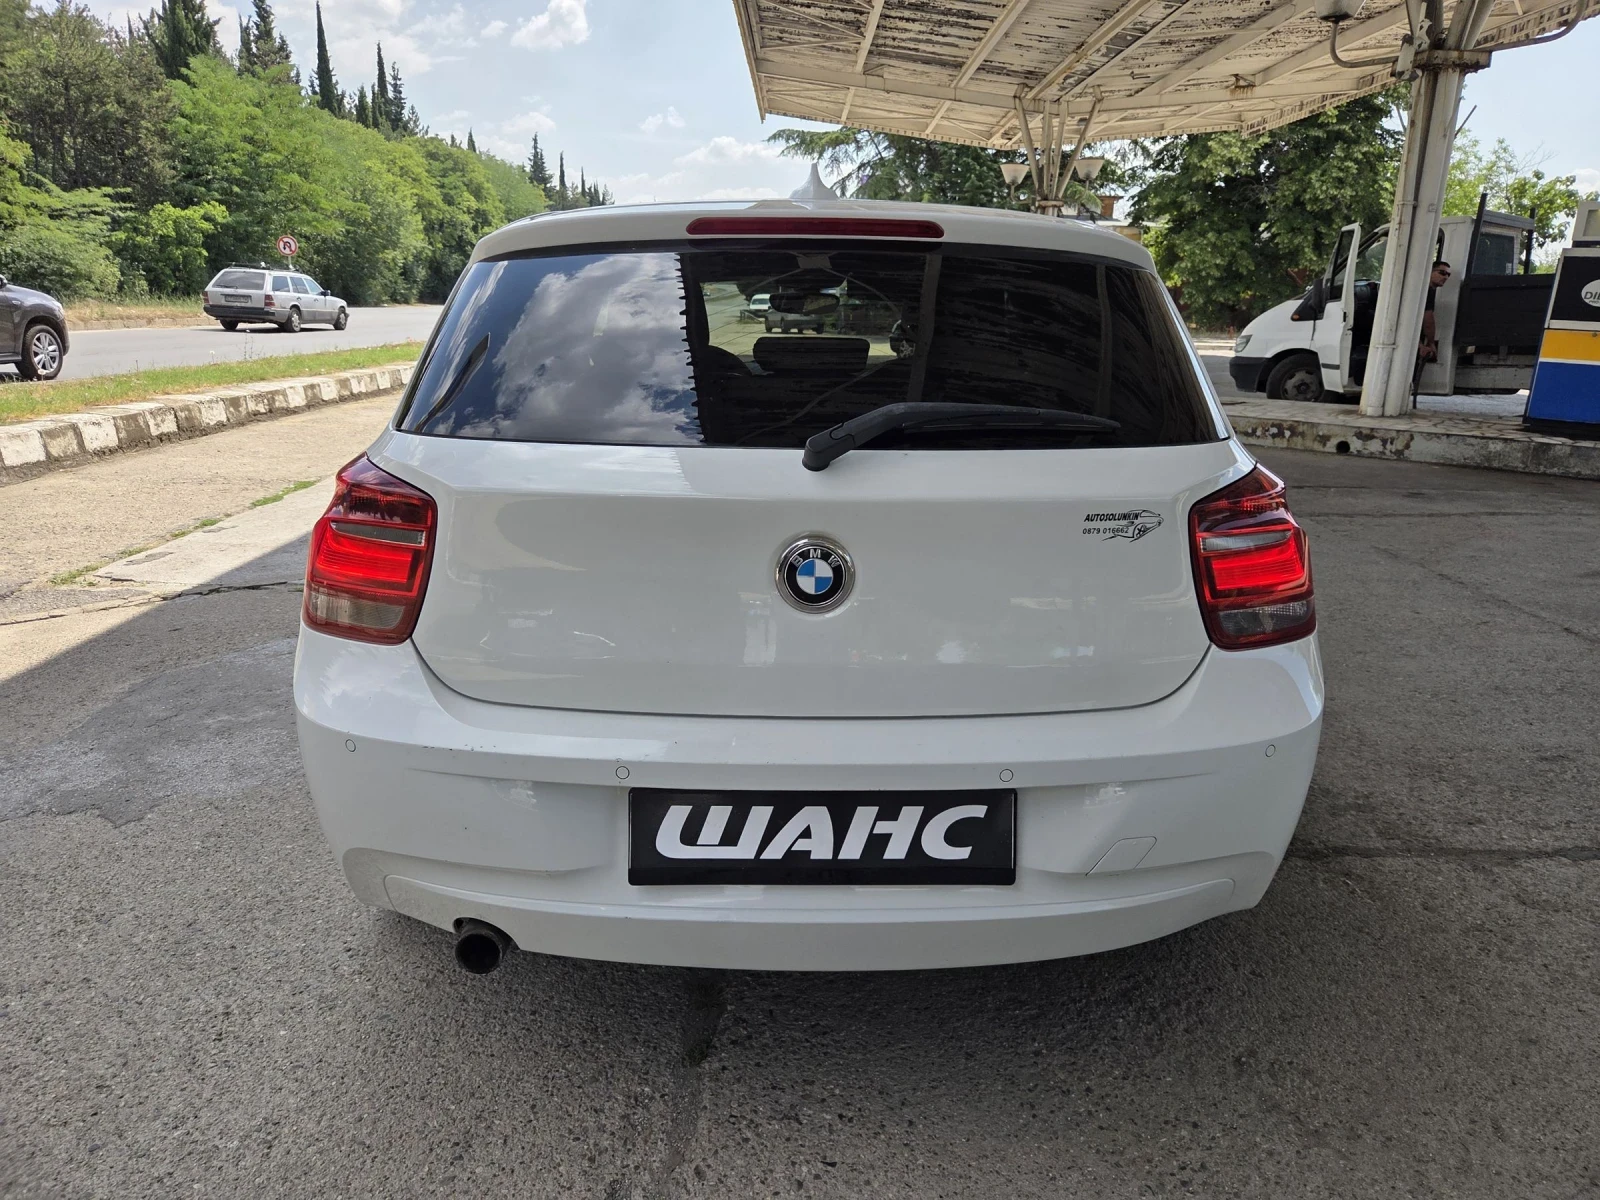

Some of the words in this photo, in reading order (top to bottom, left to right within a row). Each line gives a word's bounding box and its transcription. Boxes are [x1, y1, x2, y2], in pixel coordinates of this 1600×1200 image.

[1083, 512, 1140, 522] AUTOSOLUNKIN
[1082, 527, 1101, 535] 0879
[790, 548, 840, 568] BMW
[655, 804, 988, 860] ШАНС
